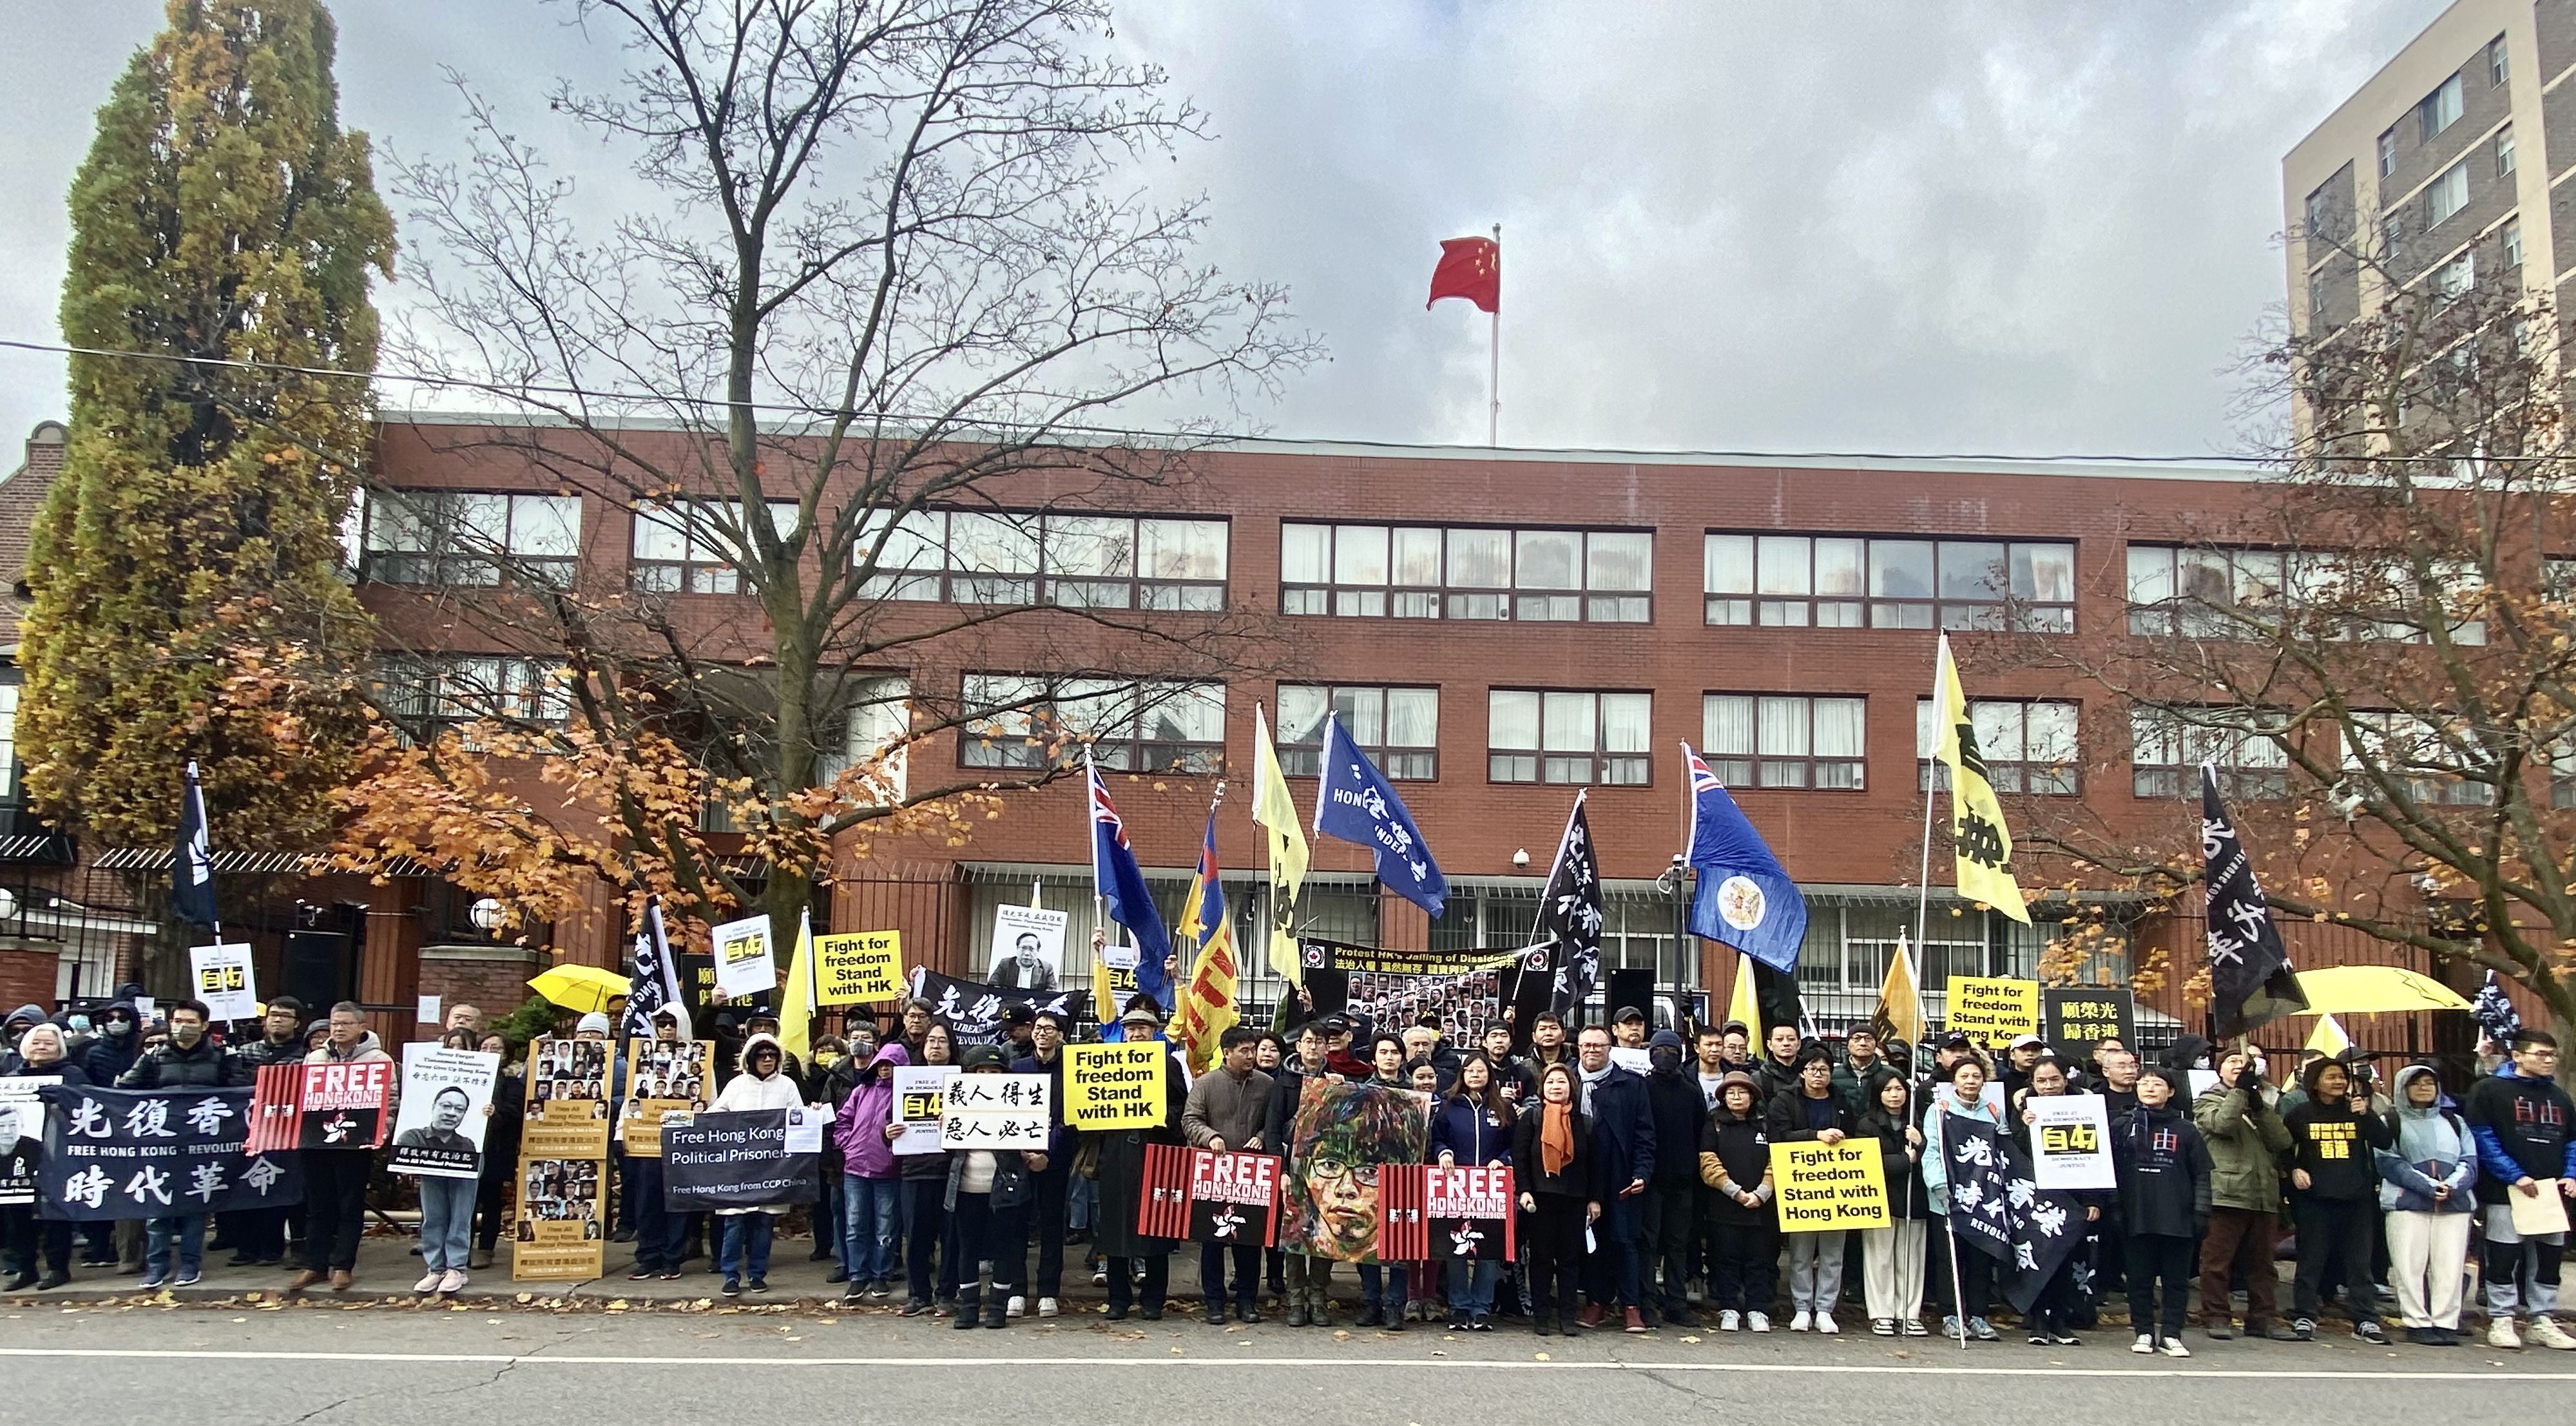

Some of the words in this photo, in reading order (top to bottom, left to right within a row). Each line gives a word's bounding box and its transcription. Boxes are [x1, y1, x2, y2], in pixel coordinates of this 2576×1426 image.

[1334, 789, 1362, 807] HON
[825, 940, 864, 954] Fight
[868, 938, 890, 949] for
[825, 953, 890, 967] freedom
[1335, 947, 1374, 958] Protest
[1378, 951, 1403, 959] HK's
[1406, 954, 1442, 963] Jailing
[1446, 954, 1457, 962] of
[836, 967, 881, 980] Stand
[828, 983, 862, 995] with
[867, 980, 892, 992] HK
[1963, 985, 1999, 997] Fight
[2004, 987, 2023, 997] for
[1963, 999, 2022, 1012] freedom
[2061, 1001, 2118, 1019] 願榮光
[1954, 1012, 1994, 1024] Stand
[1999, 1016, 2030, 1026] with
[1994, 1030, 2021, 1041] Kon
[1076, 1051, 1122, 1068] Fight
[1128, 1050, 1153, 1063] for
[305, 1063, 386, 1093] FREE
[1075, 1068, 1153, 1083] freedom
[303, 1090, 383, 1104] HONGKONG
[949, 1081, 1043, 1106] 義人得生
[1088, 1085, 1142, 1101] Stand
[1077, 1104, 1117, 1119] with
[1124, 1103, 1153, 1117] HK
[672, 1131, 705, 1144] Free
[708, 1130, 745, 1143] Hong
[749, 1127, 784, 1141] Kong
[946, 1117, 1044, 1141] 惡人必亡
[66, 1145, 97, 1156] FREE
[101, 1146, 136, 1157] HONG
[140, 1145, 177, 1157] KONG
[188, 1141, 243, 1155] REVOLUTI
[671, 1150, 726, 1164] Political
[729, 1148, 792, 1162] Prisoners
[1790, 1150, 1834, 1166] Fight
[1838, 1148, 1862, 1161] for
[1194, 1151, 1274, 1187] FREE
[1792, 1168, 1865, 1182] freedom
[64, 1156, 286, 1209] 時代革命
[673, 1186, 691, 1194] Free
[692, 1185, 716, 1194] Hong
[717, 1183, 740, 1193] Kong
[740, 1182, 762, 1191] from
[762, 1180, 781, 1189] CCP
[782, 1178, 807, 1188] China
[1192, 1179, 1271, 1199] HONGKONG
[1427, 1168, 1506, 1199] FREE
[1784, 1186, 1835, 1200] Stand
[1840, 1184, 1878, 1198] with
[1226, 1195, 1271, 1207] OPPRESSION
[1427, 1197, 1506, 1212] HONGKONG
[1785, 1207, 1832, 1221] Hong
[1836, 1204, 1881, 1219] Kong
[1970, 1218, 2010, 1244] REVOLU
